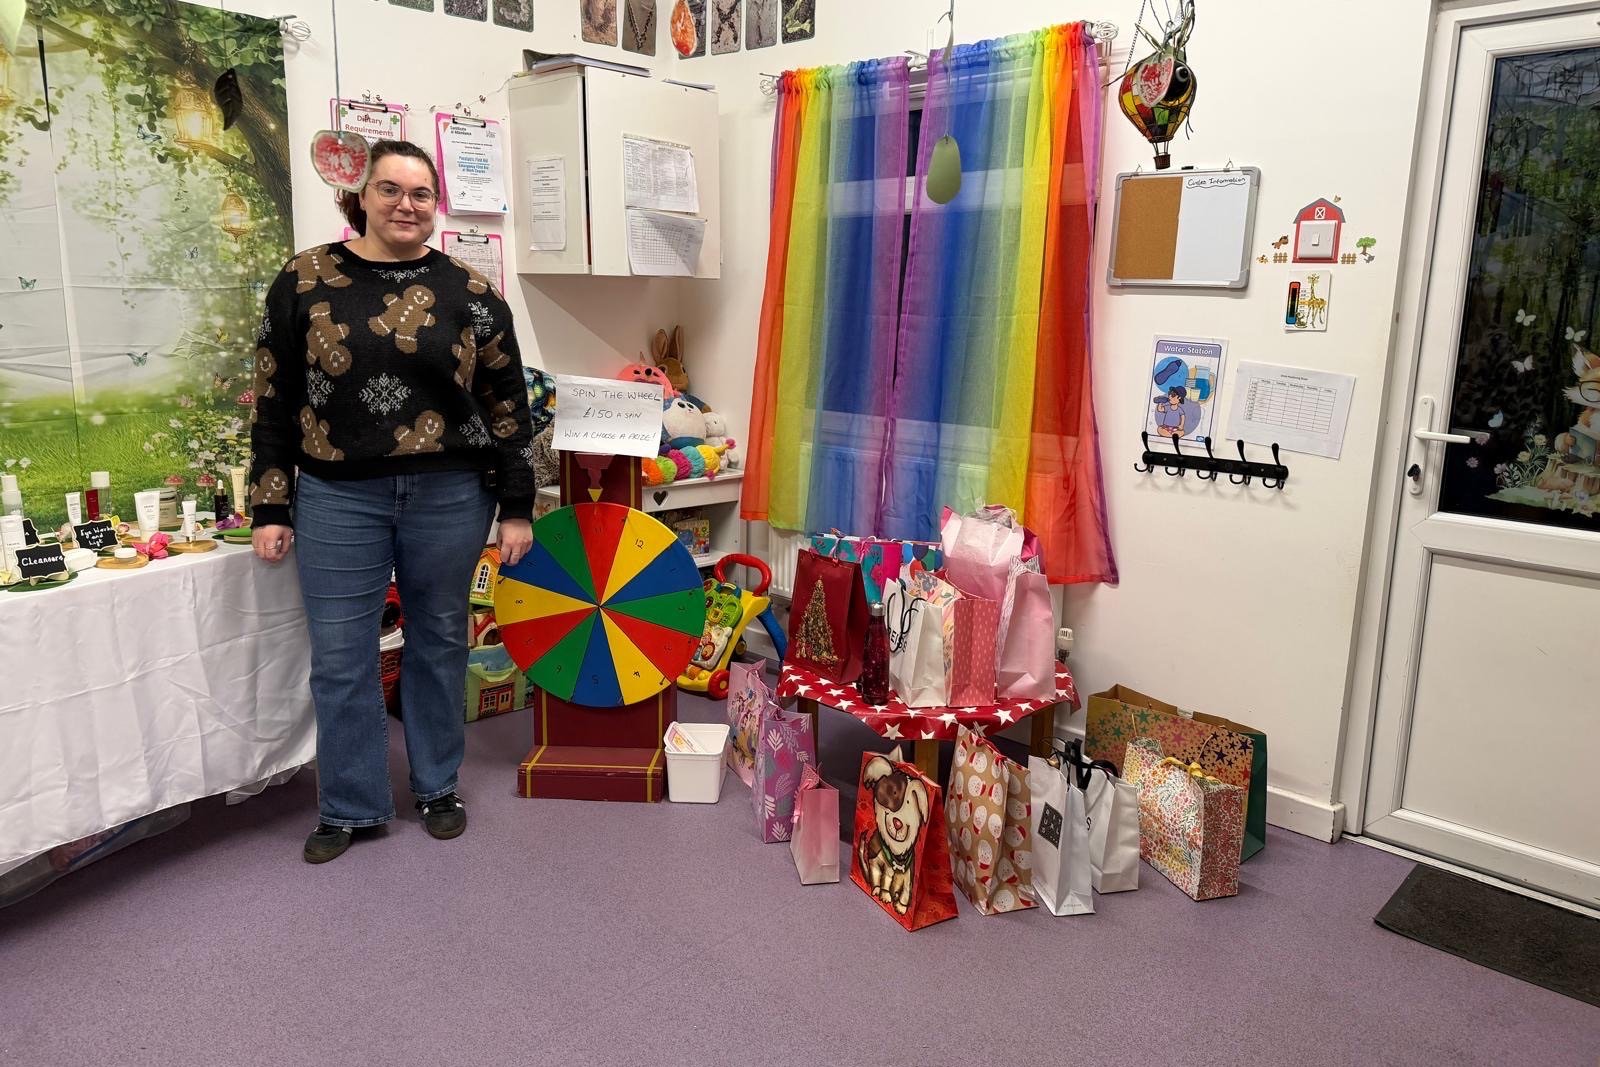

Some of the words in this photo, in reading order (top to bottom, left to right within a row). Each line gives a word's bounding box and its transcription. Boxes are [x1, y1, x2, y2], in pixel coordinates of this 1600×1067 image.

[344, 124, 394, 137] Requirements
[1187, 346, 1213, 355] Station
[571, 388, 596, 398] SPIN
[601, 390, 623, 399] THE
[628, 393, 660, 402] WHEEL
[564, 429, 580, 438] WIN
[635, 538, 644, 550] 12
[22, 555, 63, 566] Cleansers
